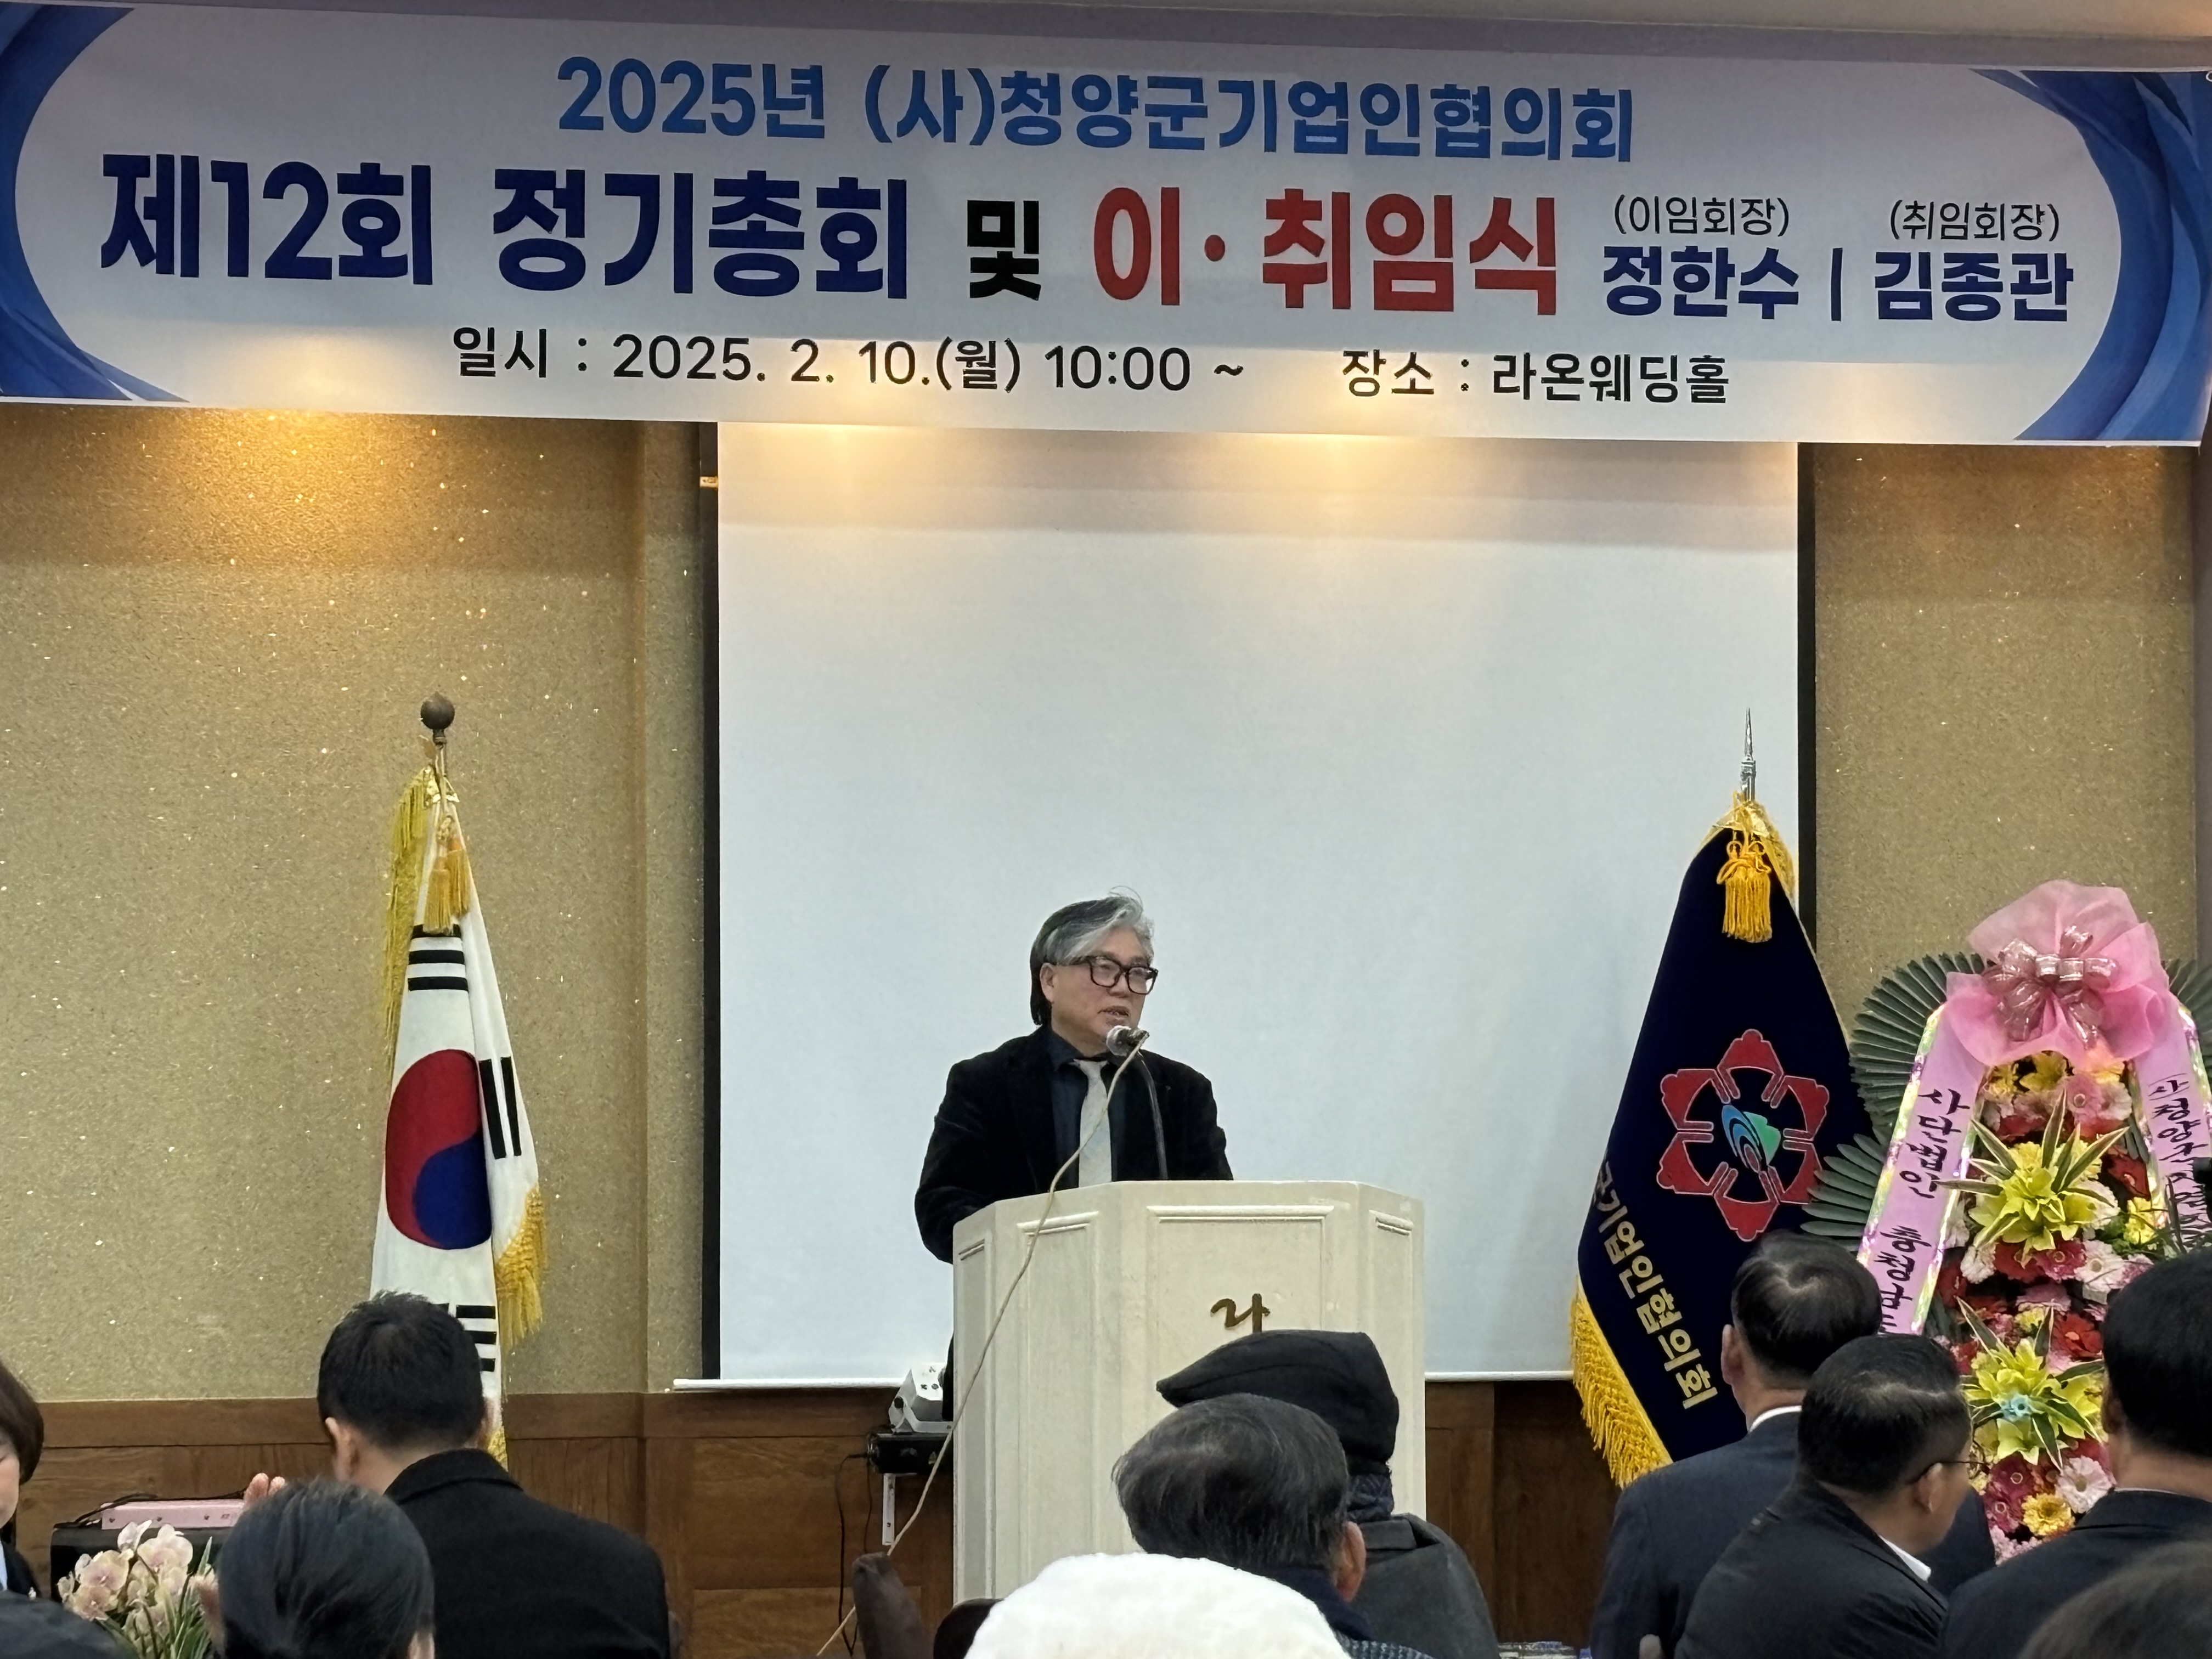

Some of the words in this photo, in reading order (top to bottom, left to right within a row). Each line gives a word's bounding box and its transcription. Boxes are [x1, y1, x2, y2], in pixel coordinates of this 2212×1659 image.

[557, 56, 825, 139] 2025년
[865, 64, 1633, 162] (사)청양군기업인협의회
[101, 154, 433, 285] 제12회
[493, 168, 907, 300] 정기총회
[967, 200, 1041, 301] 및
[1615, 194, 1789, 237] (이임회장)
[1891, 200, 2059, 242] (취임회장)
[1603, 245, 1799, 320] 정한수
[1875, 251, 2074, 322] 김종관
[453, 327, 547, 378] 일시
[1045, 345, 1190, 391] 10:00
[1342, 349, 1435, 397] 장소
[1493, 352, 1729, 404] 라온웨딩홀
